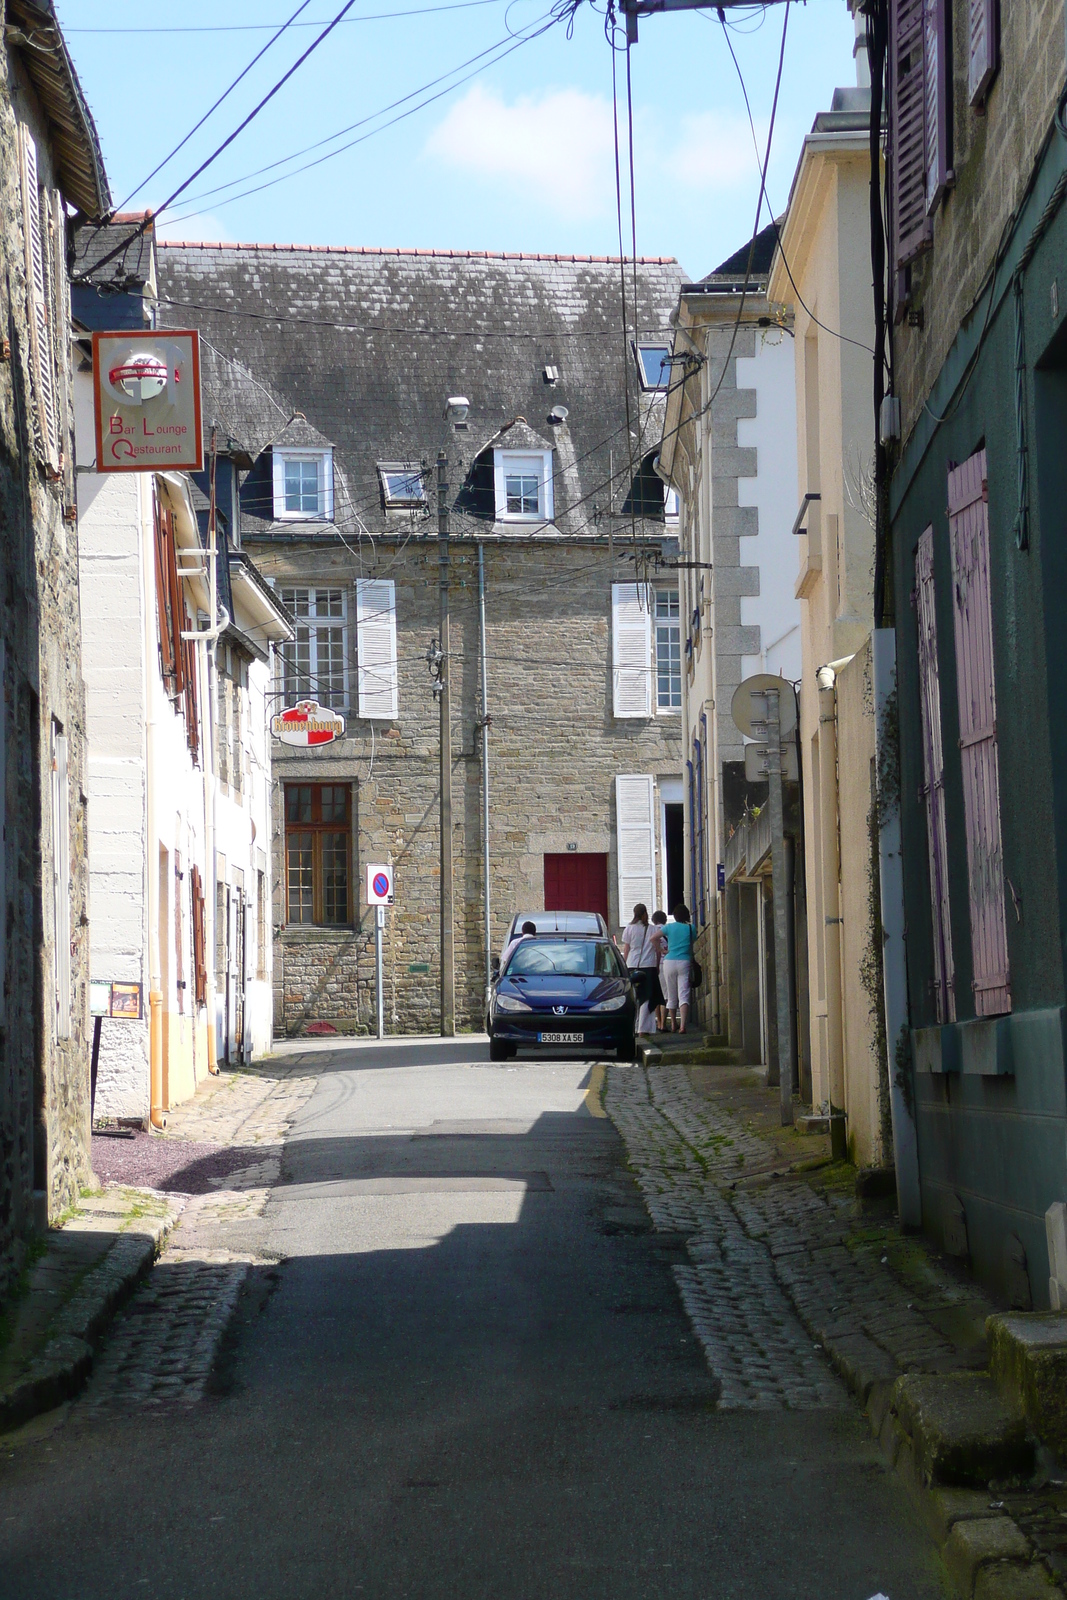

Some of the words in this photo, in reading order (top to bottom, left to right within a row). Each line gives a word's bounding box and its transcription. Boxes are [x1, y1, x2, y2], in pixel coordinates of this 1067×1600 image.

[109, 416, 136, 435] Bar
[143, 417, 187, 436] Lounge
[273, 717, 343, 735] Kronenbourg
[542, 1033, 561, 1042] 5308
[562, 1033, 572, 1042] XA
[573, 1033, 583, 1042] 56
